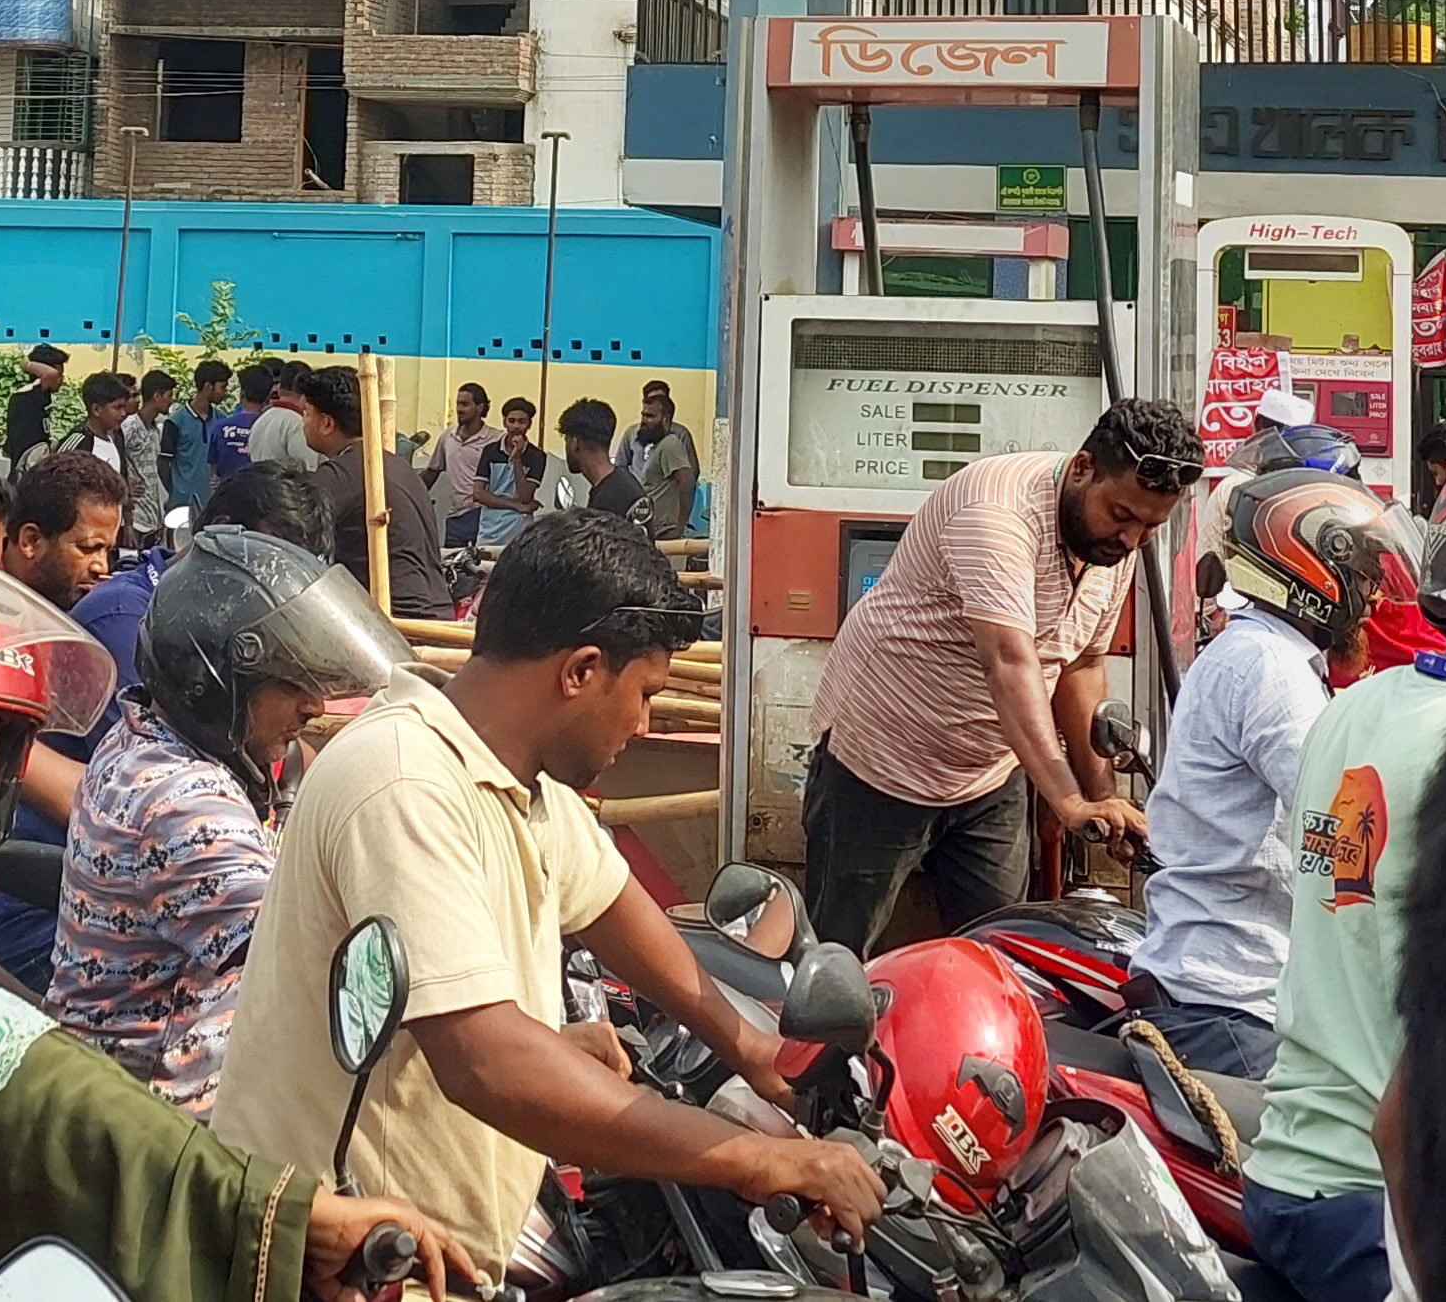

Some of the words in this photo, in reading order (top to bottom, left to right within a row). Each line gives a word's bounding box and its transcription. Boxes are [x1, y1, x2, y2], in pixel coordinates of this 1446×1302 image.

[807, 24, 1069, 78] ডিজেল
[1248, 223, 1358, 241] High-Tech
[825, 378, 895, 394] FUEL
[901, 380, 1070, 398] DISPENSER
[860, 404, 906, 419] SALE
[856, 432, 908, 448] LITER
[855, 460, 909, 475] PRICE
